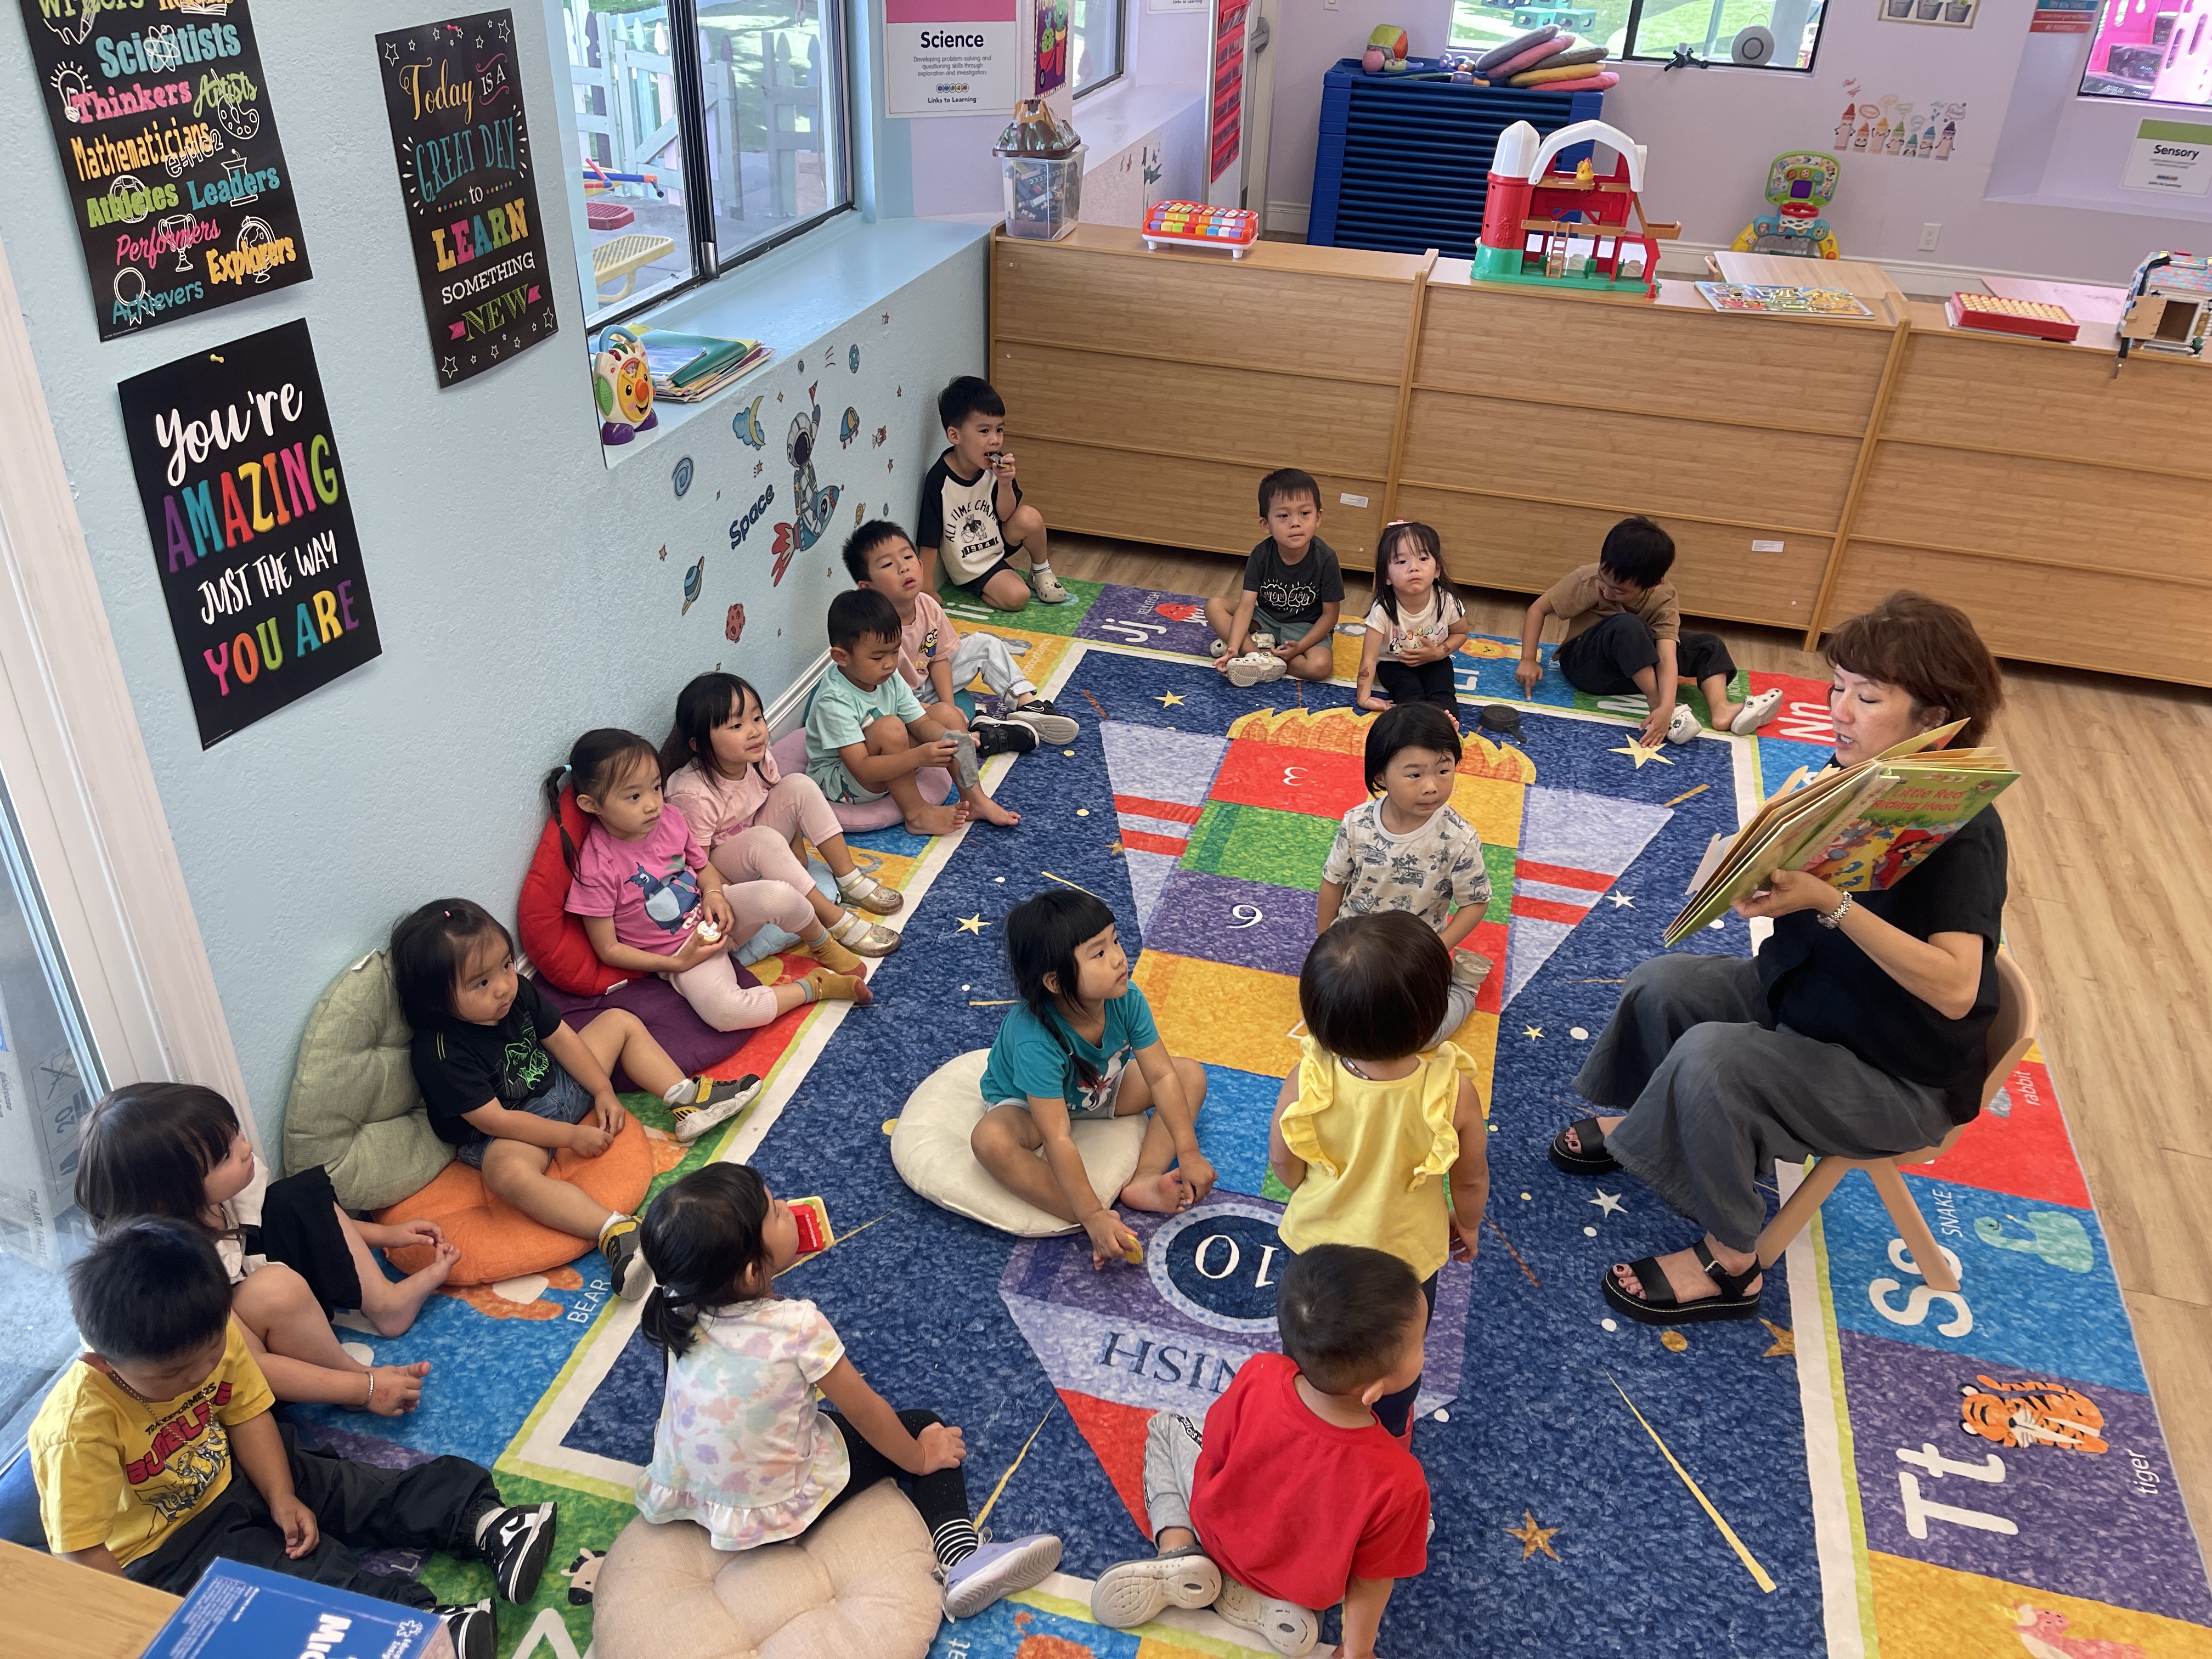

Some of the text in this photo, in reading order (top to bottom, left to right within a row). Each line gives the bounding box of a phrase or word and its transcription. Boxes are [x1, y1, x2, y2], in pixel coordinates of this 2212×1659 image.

[95, 22, 241, 78] Scientists
[921, 30, 984, 48] Science
[72, 72, 257, 123] Thinkers Artists
[399, 57, 507, 125] Today IS A
[70, 117, 213, 182] Mathematicians
[415, 117, 516, 203] GREAT DAY
[2153, 144, 2199, 160] Sensory
[86, 167, 280, 227] Athletes Leaders
[469, 186, 483, 205] to
[116, 218, 296, 285] Performers Explorers
[431, 198, 529, 272] LEARN
[112, 281, 204, 324] Achievers
[442, 251, 535, 304] SOMETHING
[461, 283, 529, 342] NEW
[156, 383, 303, 487] You're
[162, 434, 339, 573] AMAZING
[729, 484, 775, 550] Space
[945, 523, 956, 543] ALL
[951, 501, 971, 521] TIME
[966, 541, 991, 553] 1984
[198, 529, 338, 624] JUST THE WAY
[1137, 592, 1161, 615] JELLYFISH
[203, 579, 359, 696] YOU ARE
[1283, 766, 1308, 786] 3
[1892, 787, 1967, 799] Little Red
[1870, 799, 1962, 811] Riding Hood
[2013, 1069, 2041, 1106] rabbit
[805, 1212, 819, 1248] McDonald's
[1933, 1188, 1964, 1239] SNAKE
[1195, 1234, 1280, 1288] 10
[567, 1278, 611, 1323] BEAR
[1895, 1443, 2019, 1539] Tt
[2126, 1448, 2159, 1496] tiger
